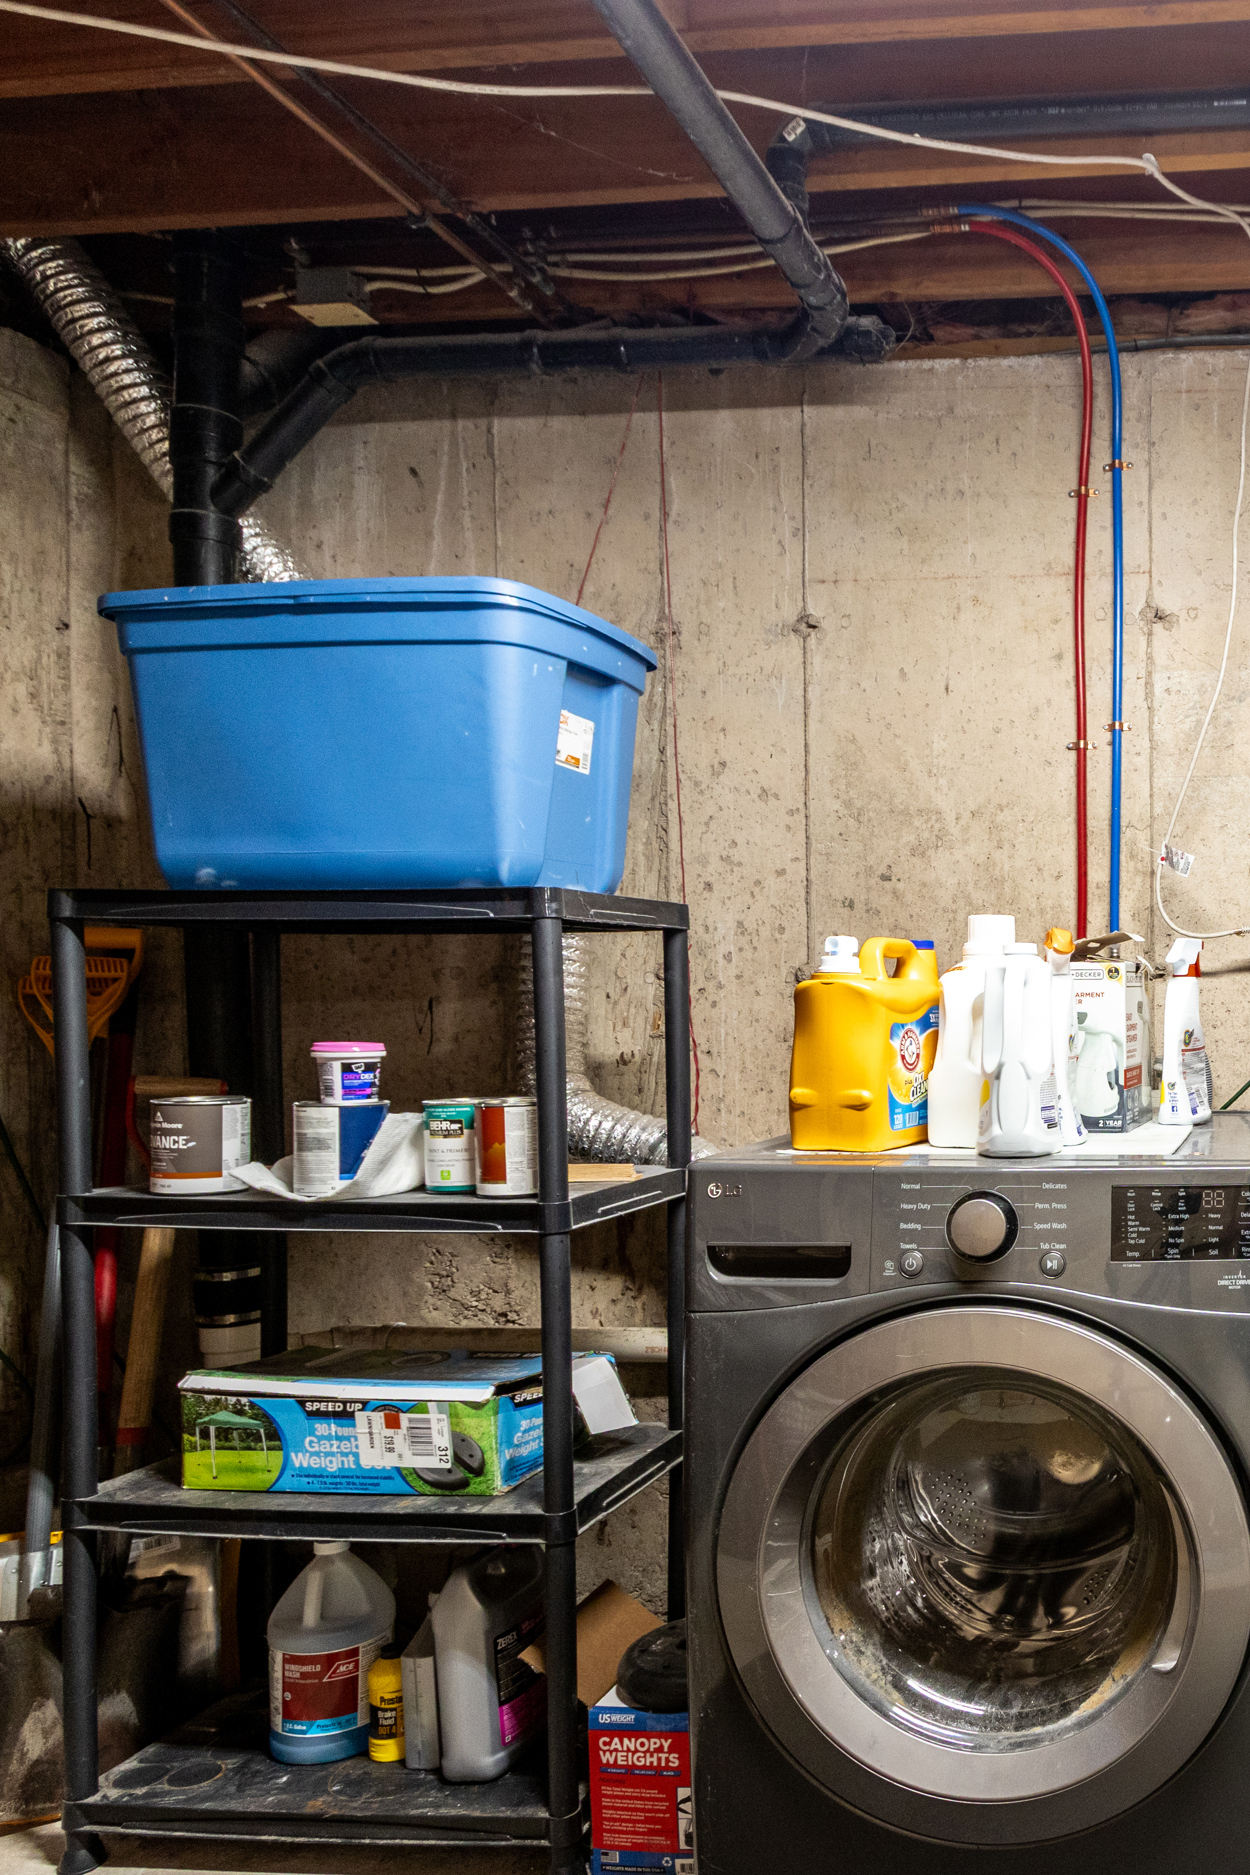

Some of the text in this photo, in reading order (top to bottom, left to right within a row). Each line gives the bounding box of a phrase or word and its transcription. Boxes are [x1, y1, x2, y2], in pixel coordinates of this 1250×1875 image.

[430, 1121, 451, 1130] BEHR
[918, 1203, 931, 1211] Duty
[1034, 1222, 1051, 1230] Speed
[305, 1401, 363, 1412] SPEED UP
[315, 1423, 357, 1436] 30-Poun
[304, 1436, 360, 1452] Gazeb
[384, 1435, 395, 1453] $19.99
[505, 1438, 539, 1460] Weight
[438, 1446, 449, 1464] 312
[291, 1452, 356, 1472] Weight
[496, 1631, 518, 1649] ZEREX
[284, 1663, 321, 1672] WINDSHIELD
[336, 1662, 356, 1673] ACE
[380, 1696, 403, 1706] Presto
[598, 1714, 635, 1723] US WEIGHT
[598, 1737, 672, 1752] CANOPY
[599, 1751, 679, 1767] WEIGHTS
